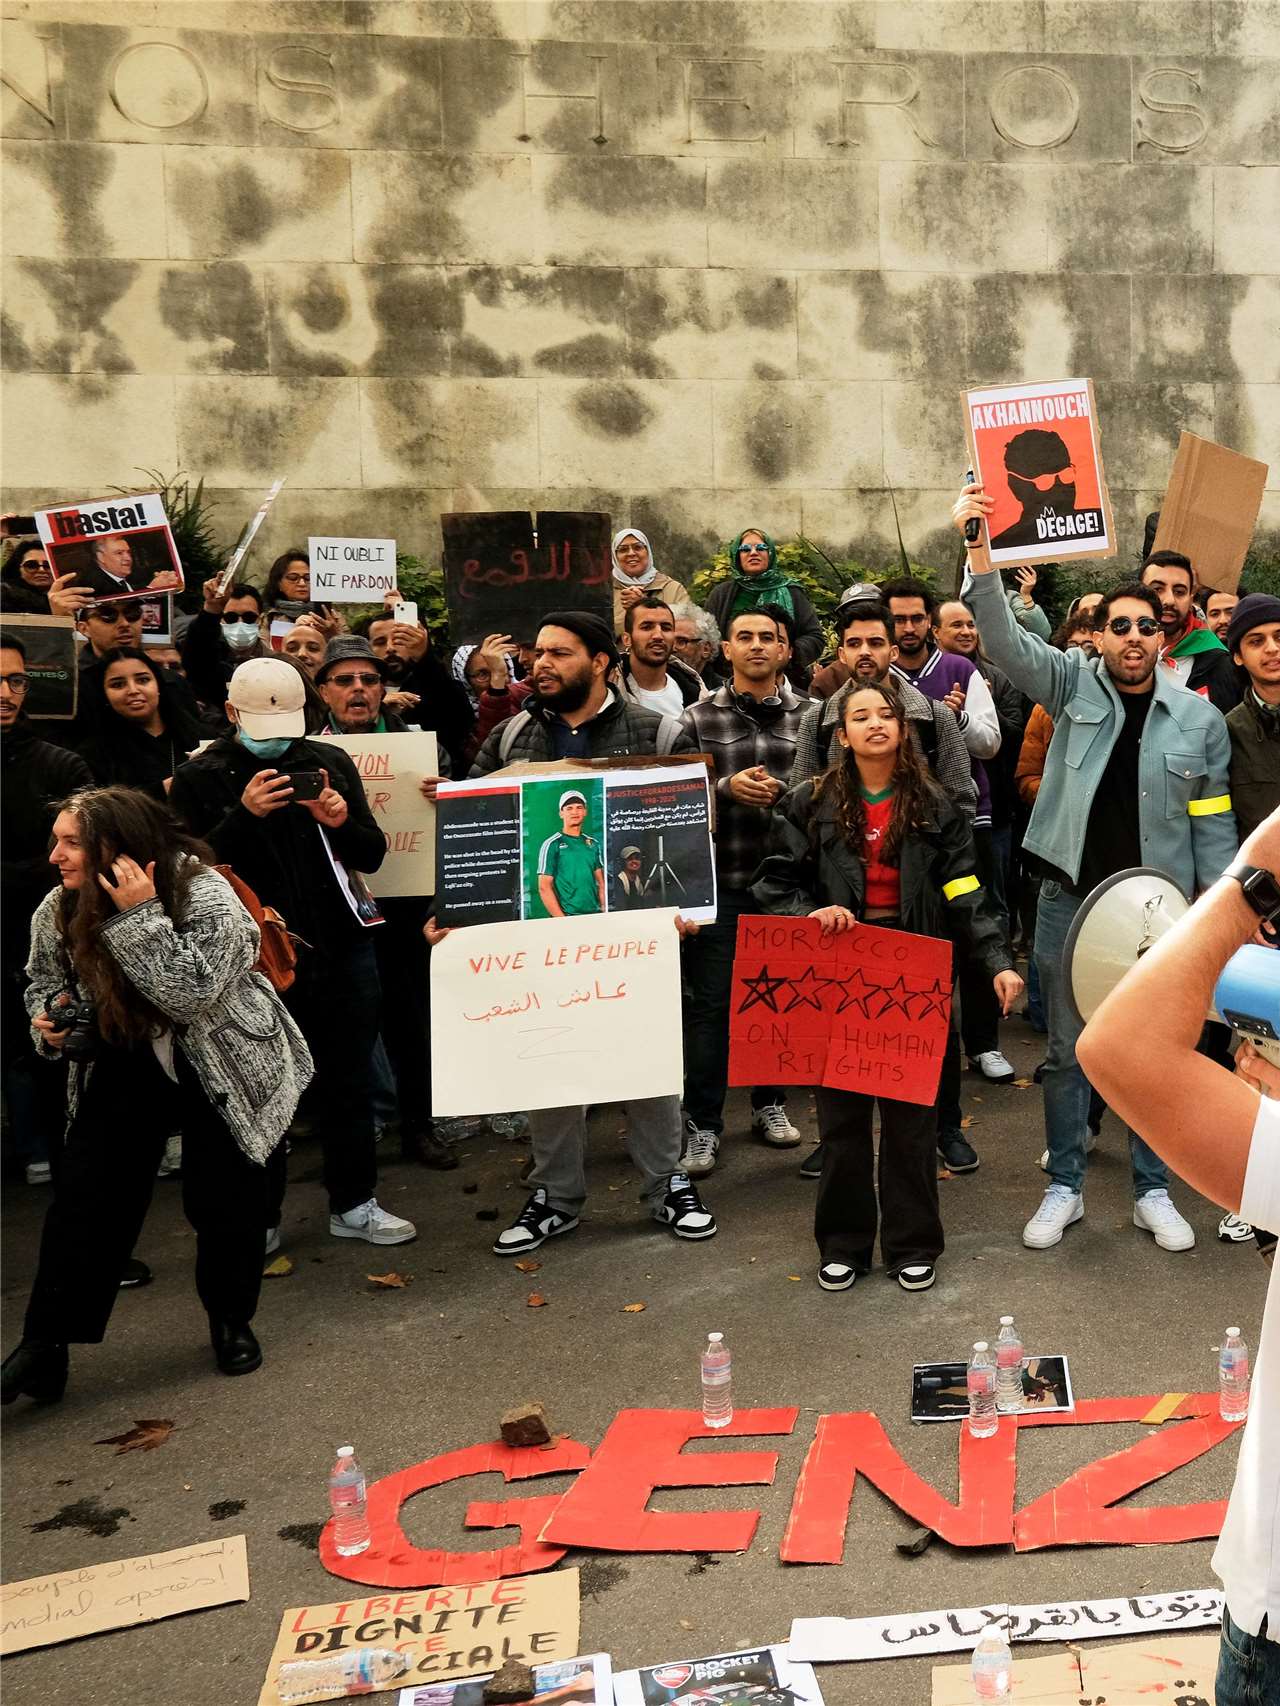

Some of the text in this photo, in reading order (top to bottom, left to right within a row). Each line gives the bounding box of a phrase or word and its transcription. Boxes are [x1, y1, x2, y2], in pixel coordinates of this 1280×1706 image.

[972, 391, 1089, 430] AKHANNOUCH
[53, 502, 146, 538] basta!
[317, 546, 385, 562] NI OUBLI
[316, 573, 394, 590] NI PARDON
[469, 940, 659, 974] VIVE LE PEUPLE
[463, 980, 627, 1022] عاش الشعب
[747, 1022, 935, 1058] ON HUMAN
[416, 1631, 559, 1672] CIALE
[694, 1654, 760, 1672] ROCKET
[696, 1669, 726, 1681] PIG
